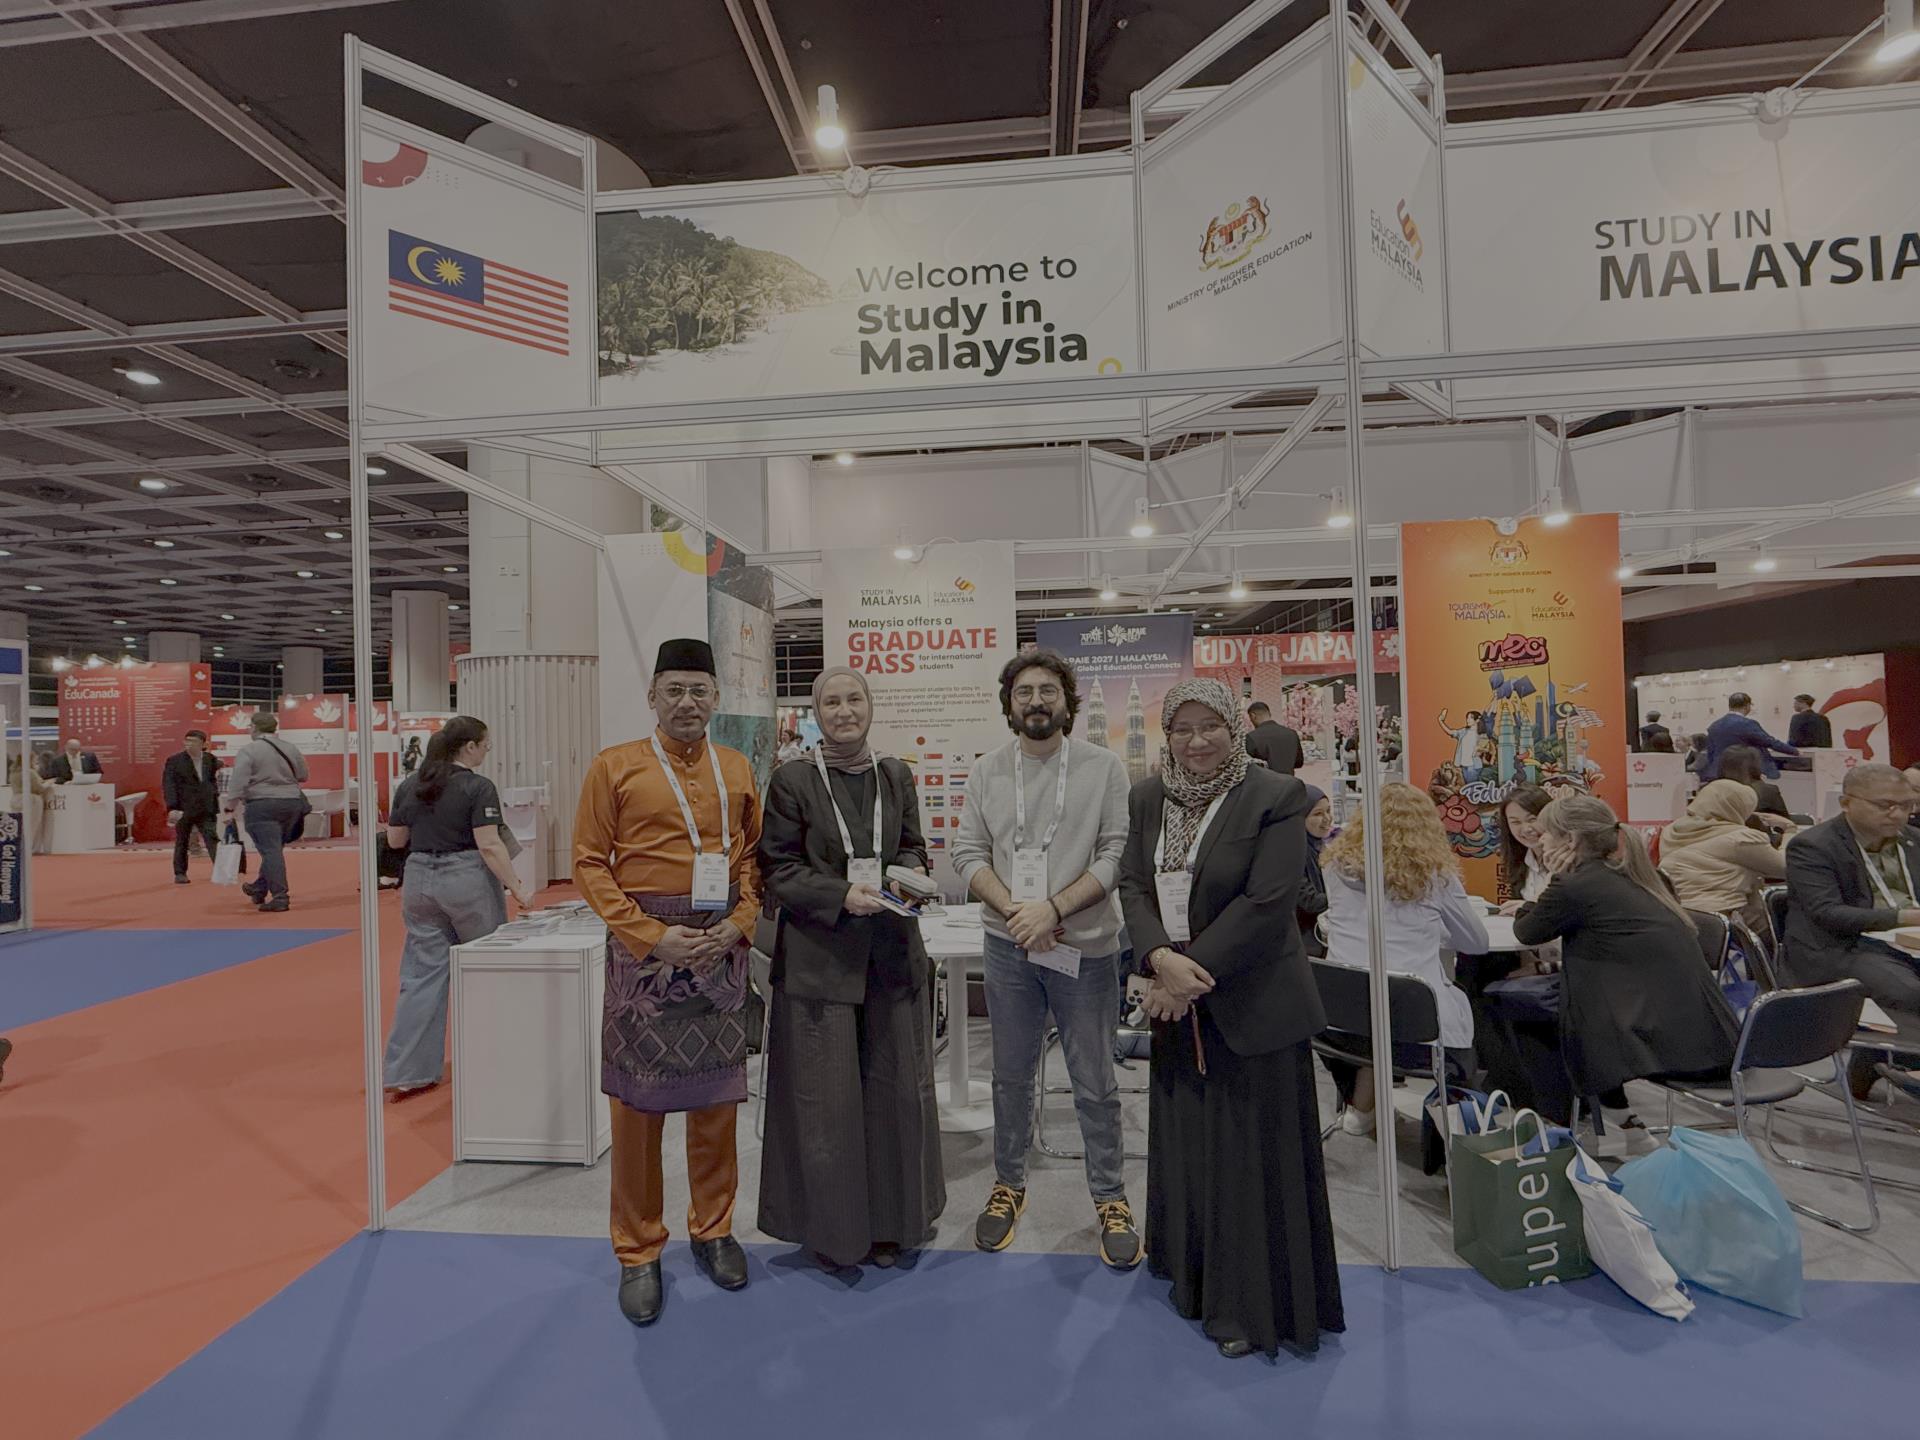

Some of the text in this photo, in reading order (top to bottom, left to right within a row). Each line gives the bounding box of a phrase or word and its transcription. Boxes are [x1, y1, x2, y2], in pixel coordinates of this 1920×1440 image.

[1370, 208, 1410, 257] Education
[1594, 208, 1771, 250] STUDY IN
[1370, 230, 1424, 286] MALAYSIA
[1600, 232, 1920, 301] MALAYSIA
[856, 255, 1077, 293] Welcome to
[1167, 231, 1313, 312] MINISTRY OF HIGHER EDUCATION
[1213, 270, 1257, 296] MALAYSIA
[857, 290, 1042, 336] Study in
[859, 322, 1088, 377] Malaysia
[860, 589, 884, 597] STUDY
[861, 595, 922, 607] MALAYSIA
[1488, 587, 1524, 595] Supported
[848, 616, 952, 630] Malaysia offers a
[1454, 609, 1506, 624] MALAYSIA
[1532, 611, 1575, 619] MALAYSIA
[848, 628, 997, 652] GRADUATE
[1256, 641, 1278, 663] in
[1282, 634, 1356, 663] JAPA
[849, 653, 915, 675] PASS
[919, 652, 983, 661] for international
[919, 662, 954, 671] students
[1077, 664, 1102, 672] Global
[1103, 663, 1143, 671] Education
[1092, 655, 1113, 664] 2027
[1120, 653, 1168, 662] MALAYSIA
[64, 688, 120, 699] EduCanada
